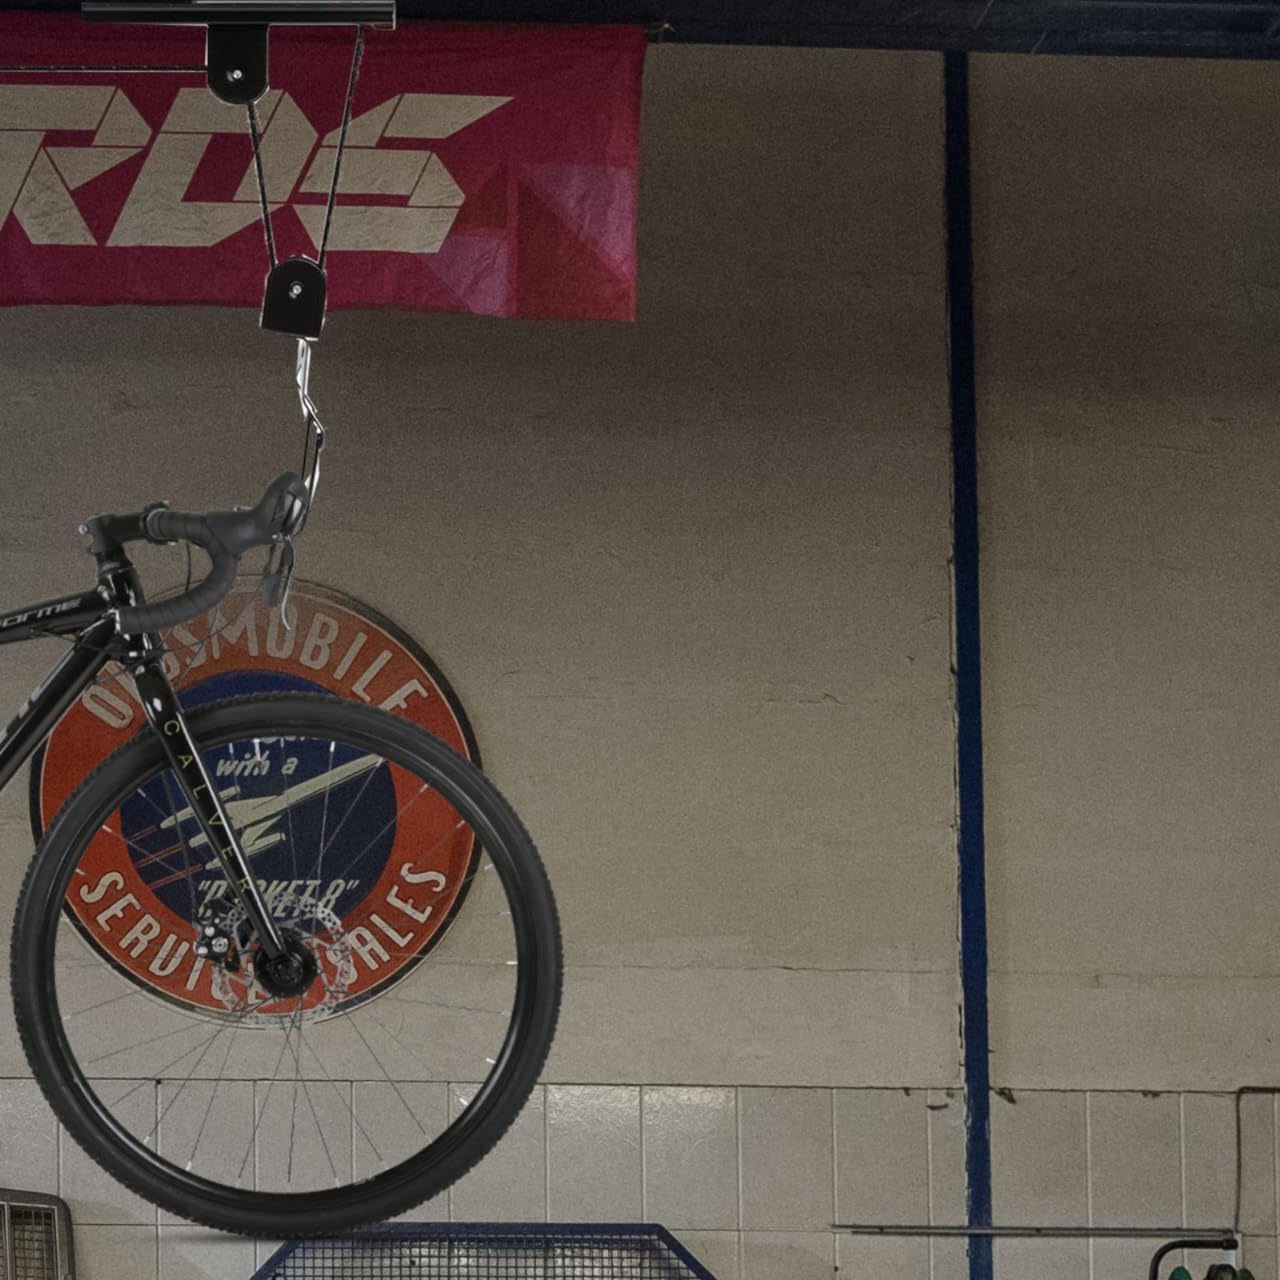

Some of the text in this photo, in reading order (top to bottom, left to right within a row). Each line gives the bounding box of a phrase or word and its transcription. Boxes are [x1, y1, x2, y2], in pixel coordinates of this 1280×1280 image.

[81, 602, 430, 730] OSMOBILE
[215, 751, 298, 777] with a
